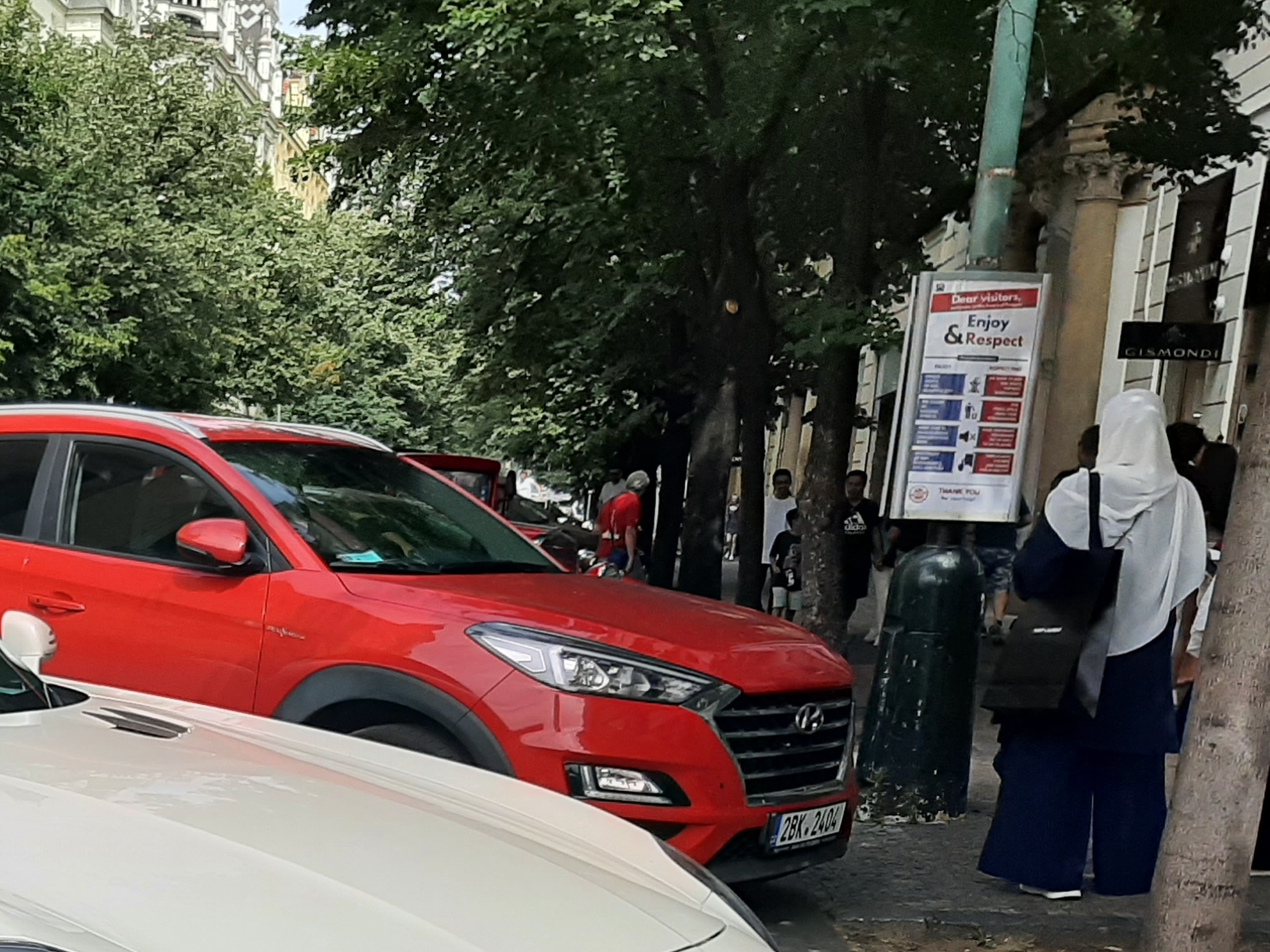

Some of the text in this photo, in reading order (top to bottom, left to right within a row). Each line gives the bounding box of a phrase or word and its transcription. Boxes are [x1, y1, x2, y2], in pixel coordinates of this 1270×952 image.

[951, 291, 1022, 305] Dear visitors,
[968, 314, 1010, 332] Enjoy
[944, 324, 1024, 350] & Respect
[1125, 348, 1219, 359] GISMONDI
[781, 807, 840, 842] 2BK 2404
